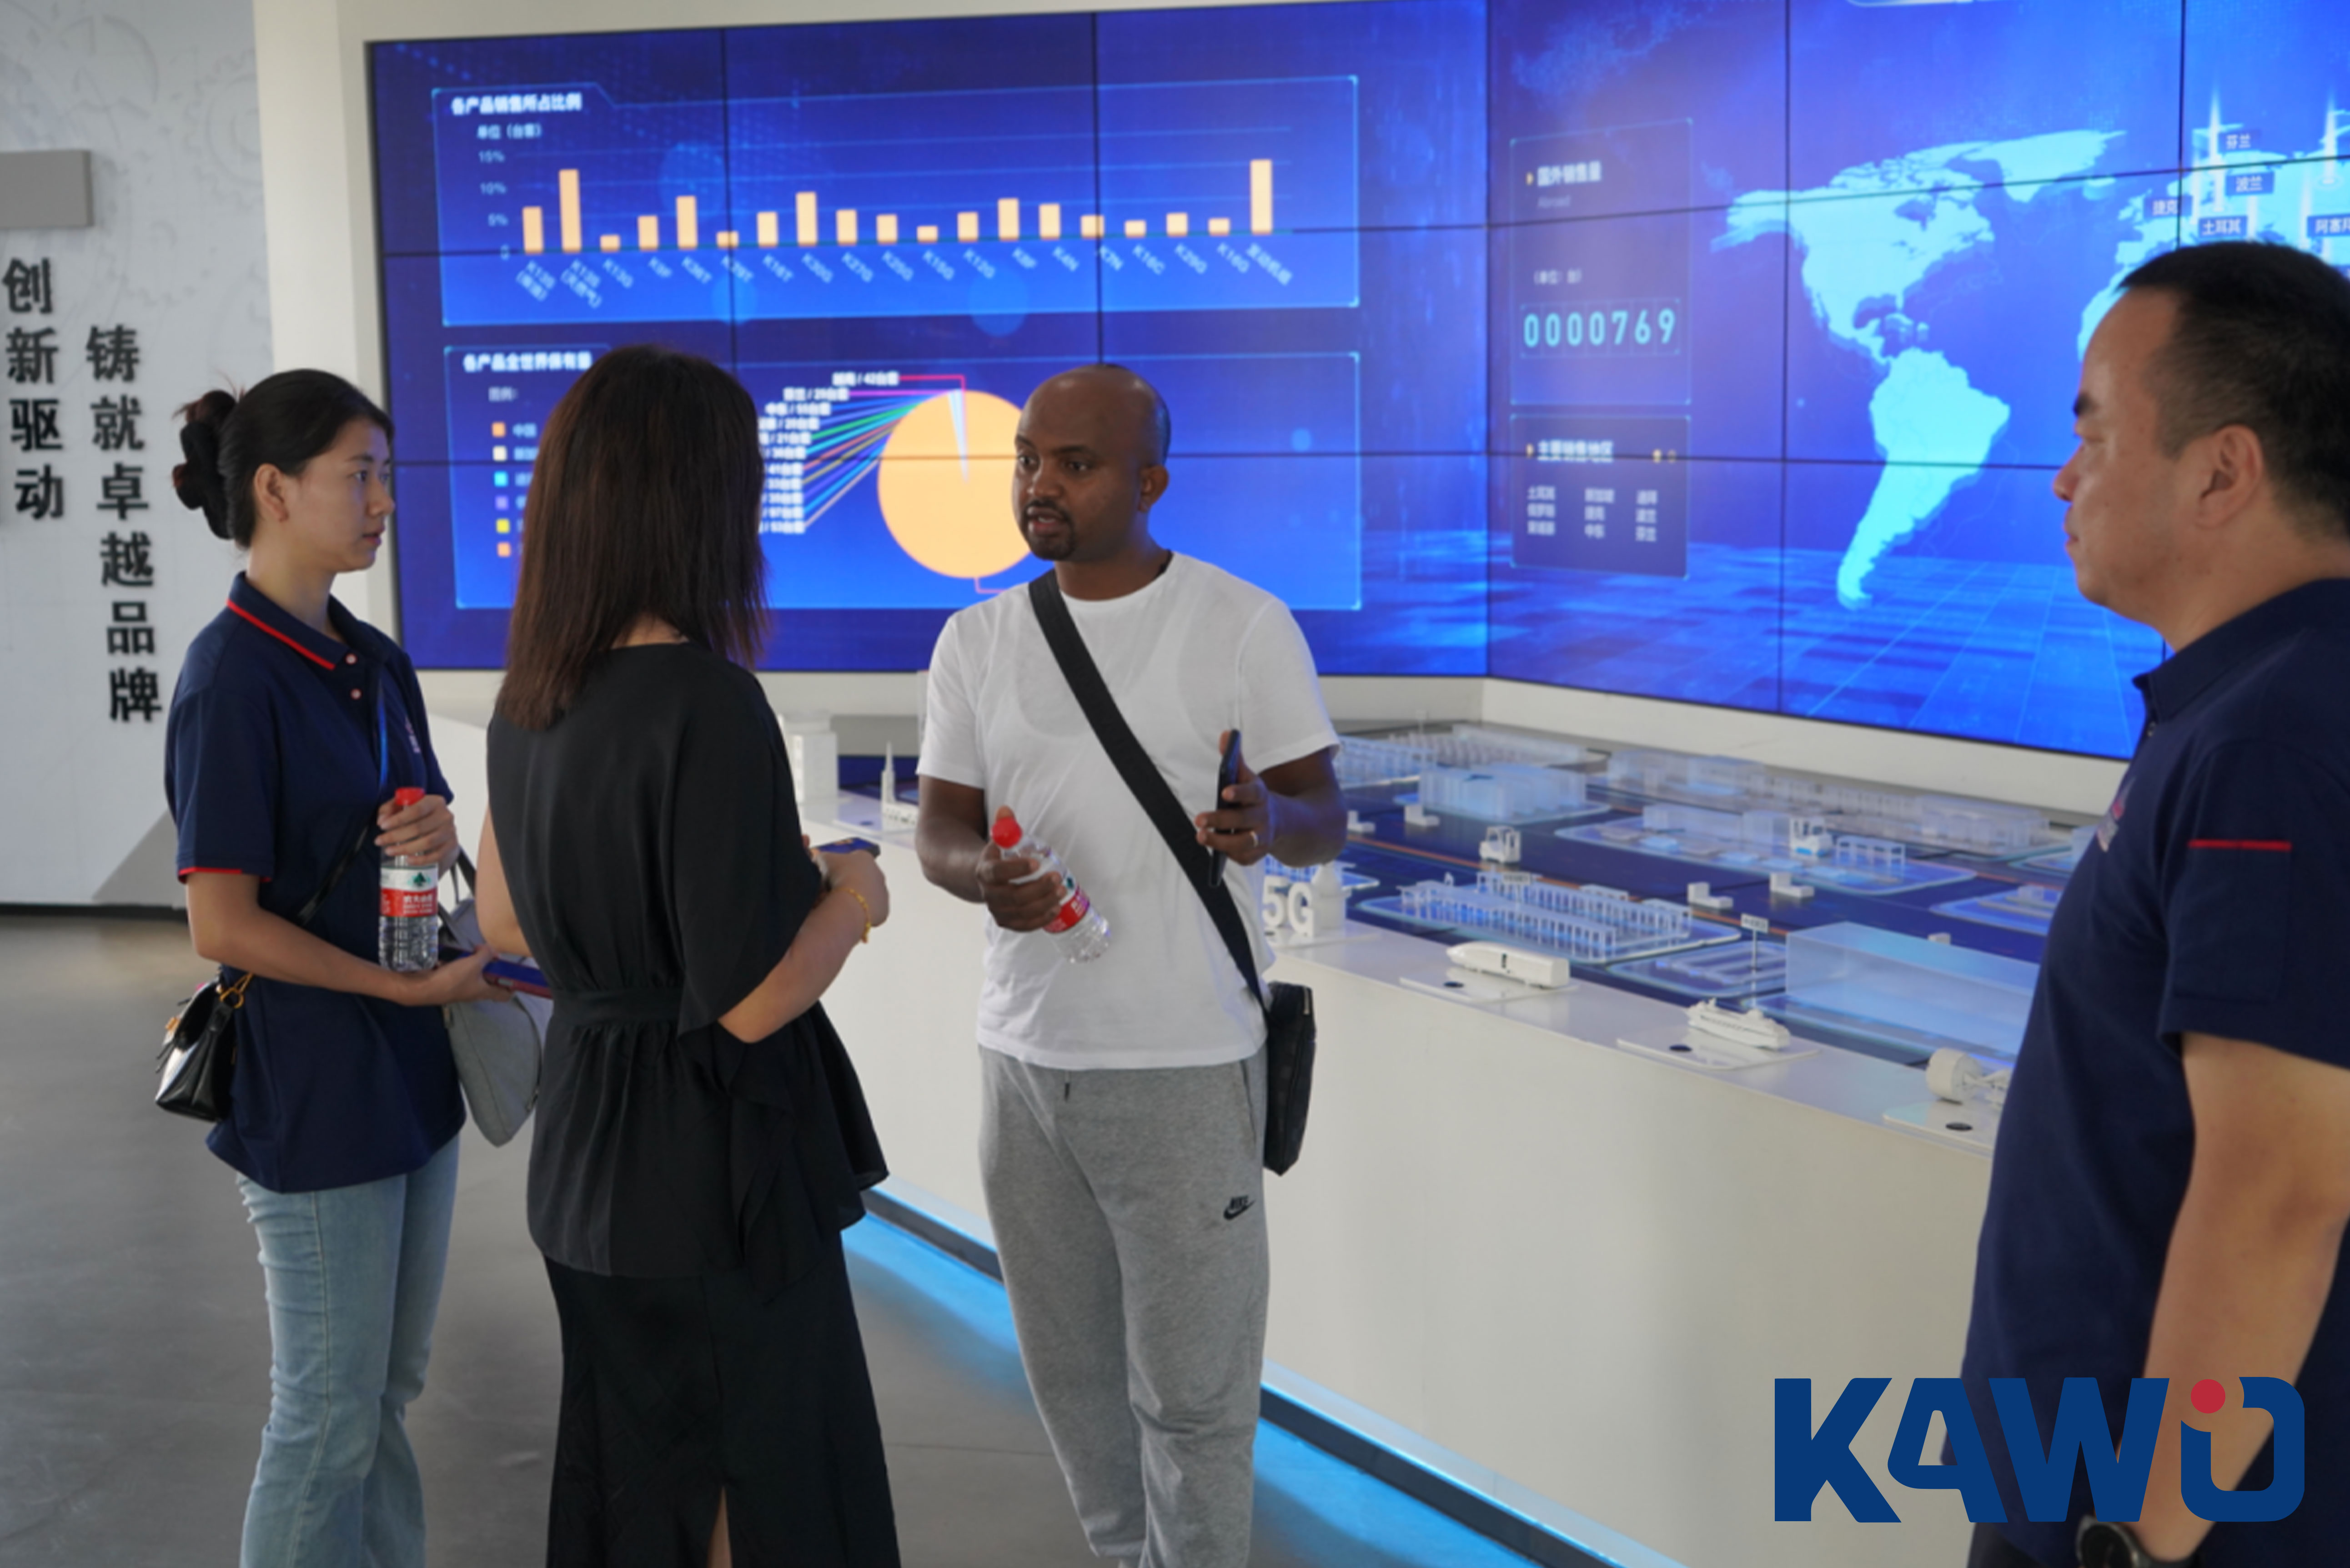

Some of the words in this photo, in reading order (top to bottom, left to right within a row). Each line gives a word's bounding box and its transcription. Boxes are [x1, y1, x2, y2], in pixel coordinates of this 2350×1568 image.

[2226, 134, 2251, 149] 芬兰
[2236, 176, 2262, 192] 波兰
[2202, 220, 2241, 236] 土耳其
[1523, 308, 1676, 348] 0000769
[2, 257, 65, 520] 创新驱动
[85, 323, 162, 724] 铸就卓越品牌
[1262, 876, 1315, 937] 5G
